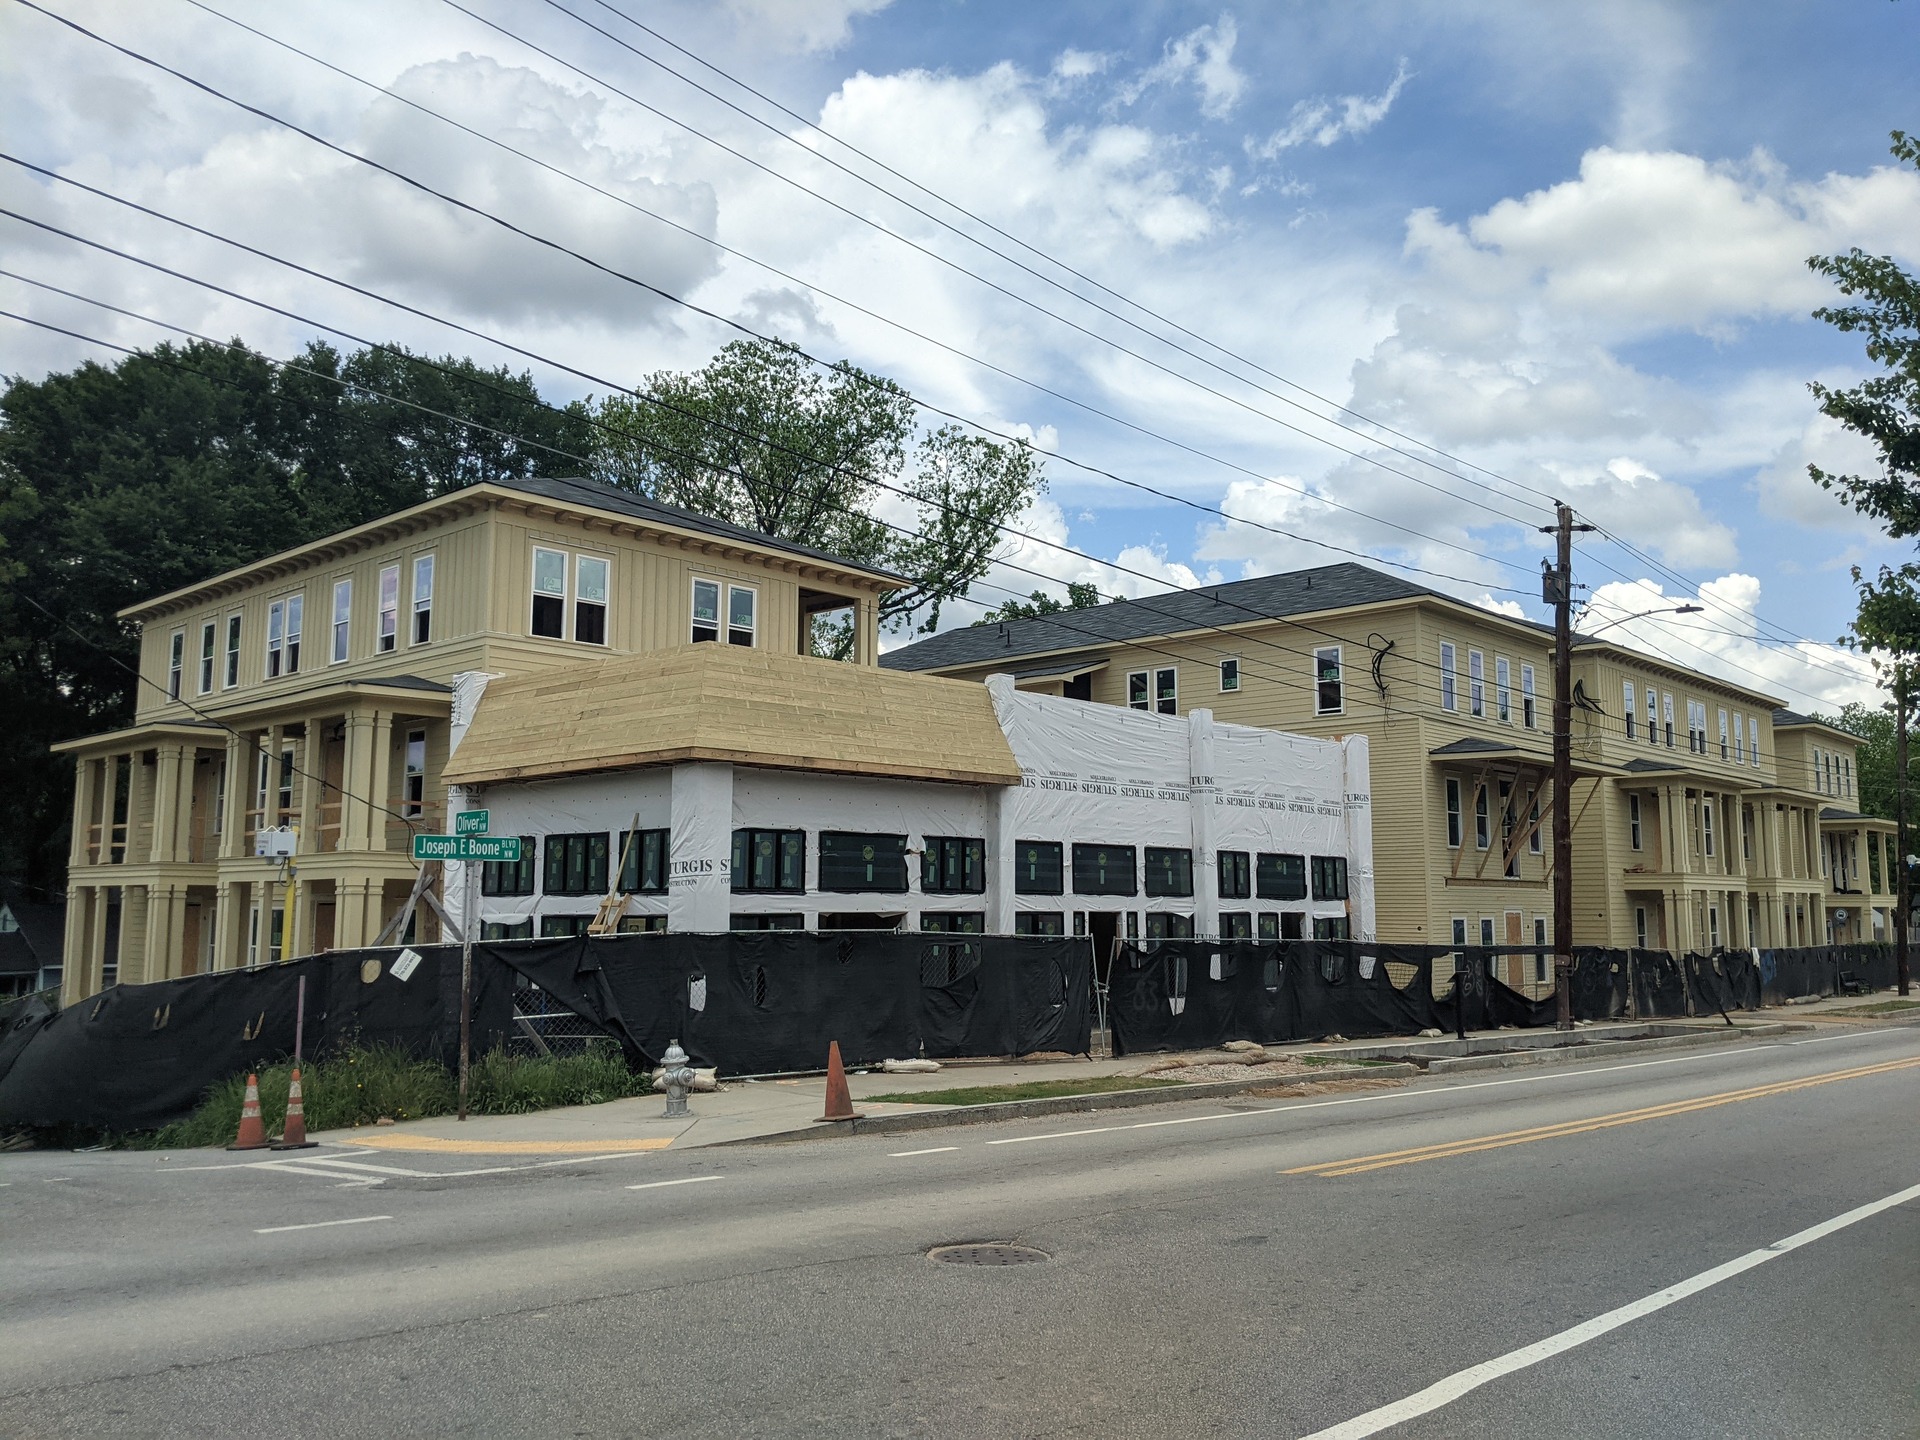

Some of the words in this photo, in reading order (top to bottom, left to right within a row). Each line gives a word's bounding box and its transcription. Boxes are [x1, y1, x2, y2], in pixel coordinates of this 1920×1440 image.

[1040, 779, 1078, 792] STURGIS
[1081, 783, 1117, 796] STURGIS
[1120, 786, 1155, 799] STURGIS
[1158, 790, 1190, 802] STURGIS
[1226, 797, 1256, 808] STURGIS
[1258, 800, 1286, 810] STURGIS
[1288, 802, 1315, 814] STURGIS
[1317, 806, 1342, 817] STURGIS
[457, 815, 480, 832] Oliver
[480, 812, 486, 821] ST
[479, 822, 487, 831] NW
[418, 837, 457, 857] Joseph
[460, 838, 467, 855] E
[469, 839, 500, 856] Boone
[501, 840, 517, 849] BLVD
[504, 850, 513, 859] NW
